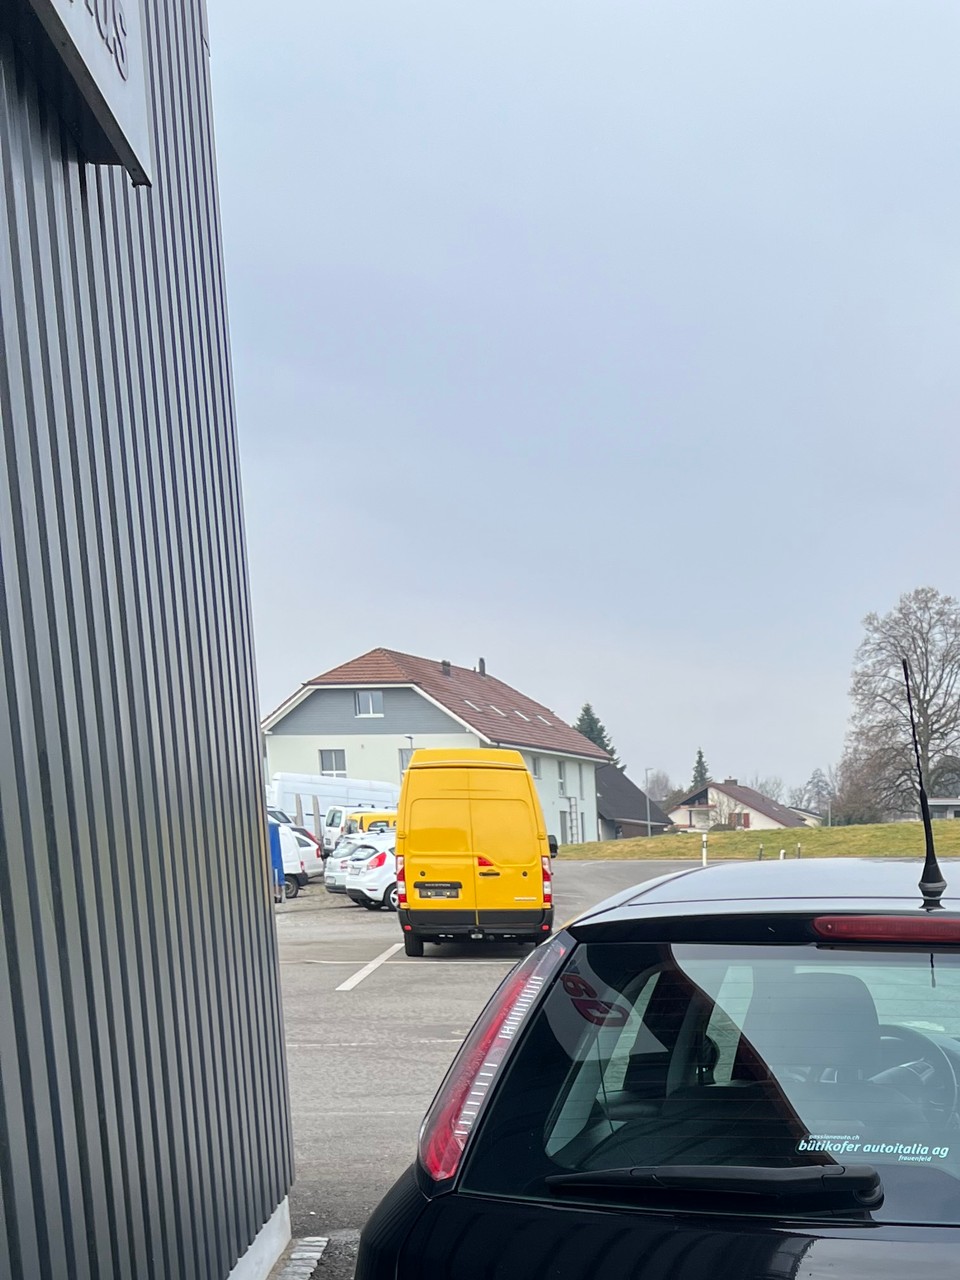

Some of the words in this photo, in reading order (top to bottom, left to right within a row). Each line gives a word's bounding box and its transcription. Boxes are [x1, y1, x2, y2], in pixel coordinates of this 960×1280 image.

[798, 1140, 861, 1154] bütikofer
[862, 1143, 929, 1155] autoitalia
[931, 1146, 949, 1158] ag
